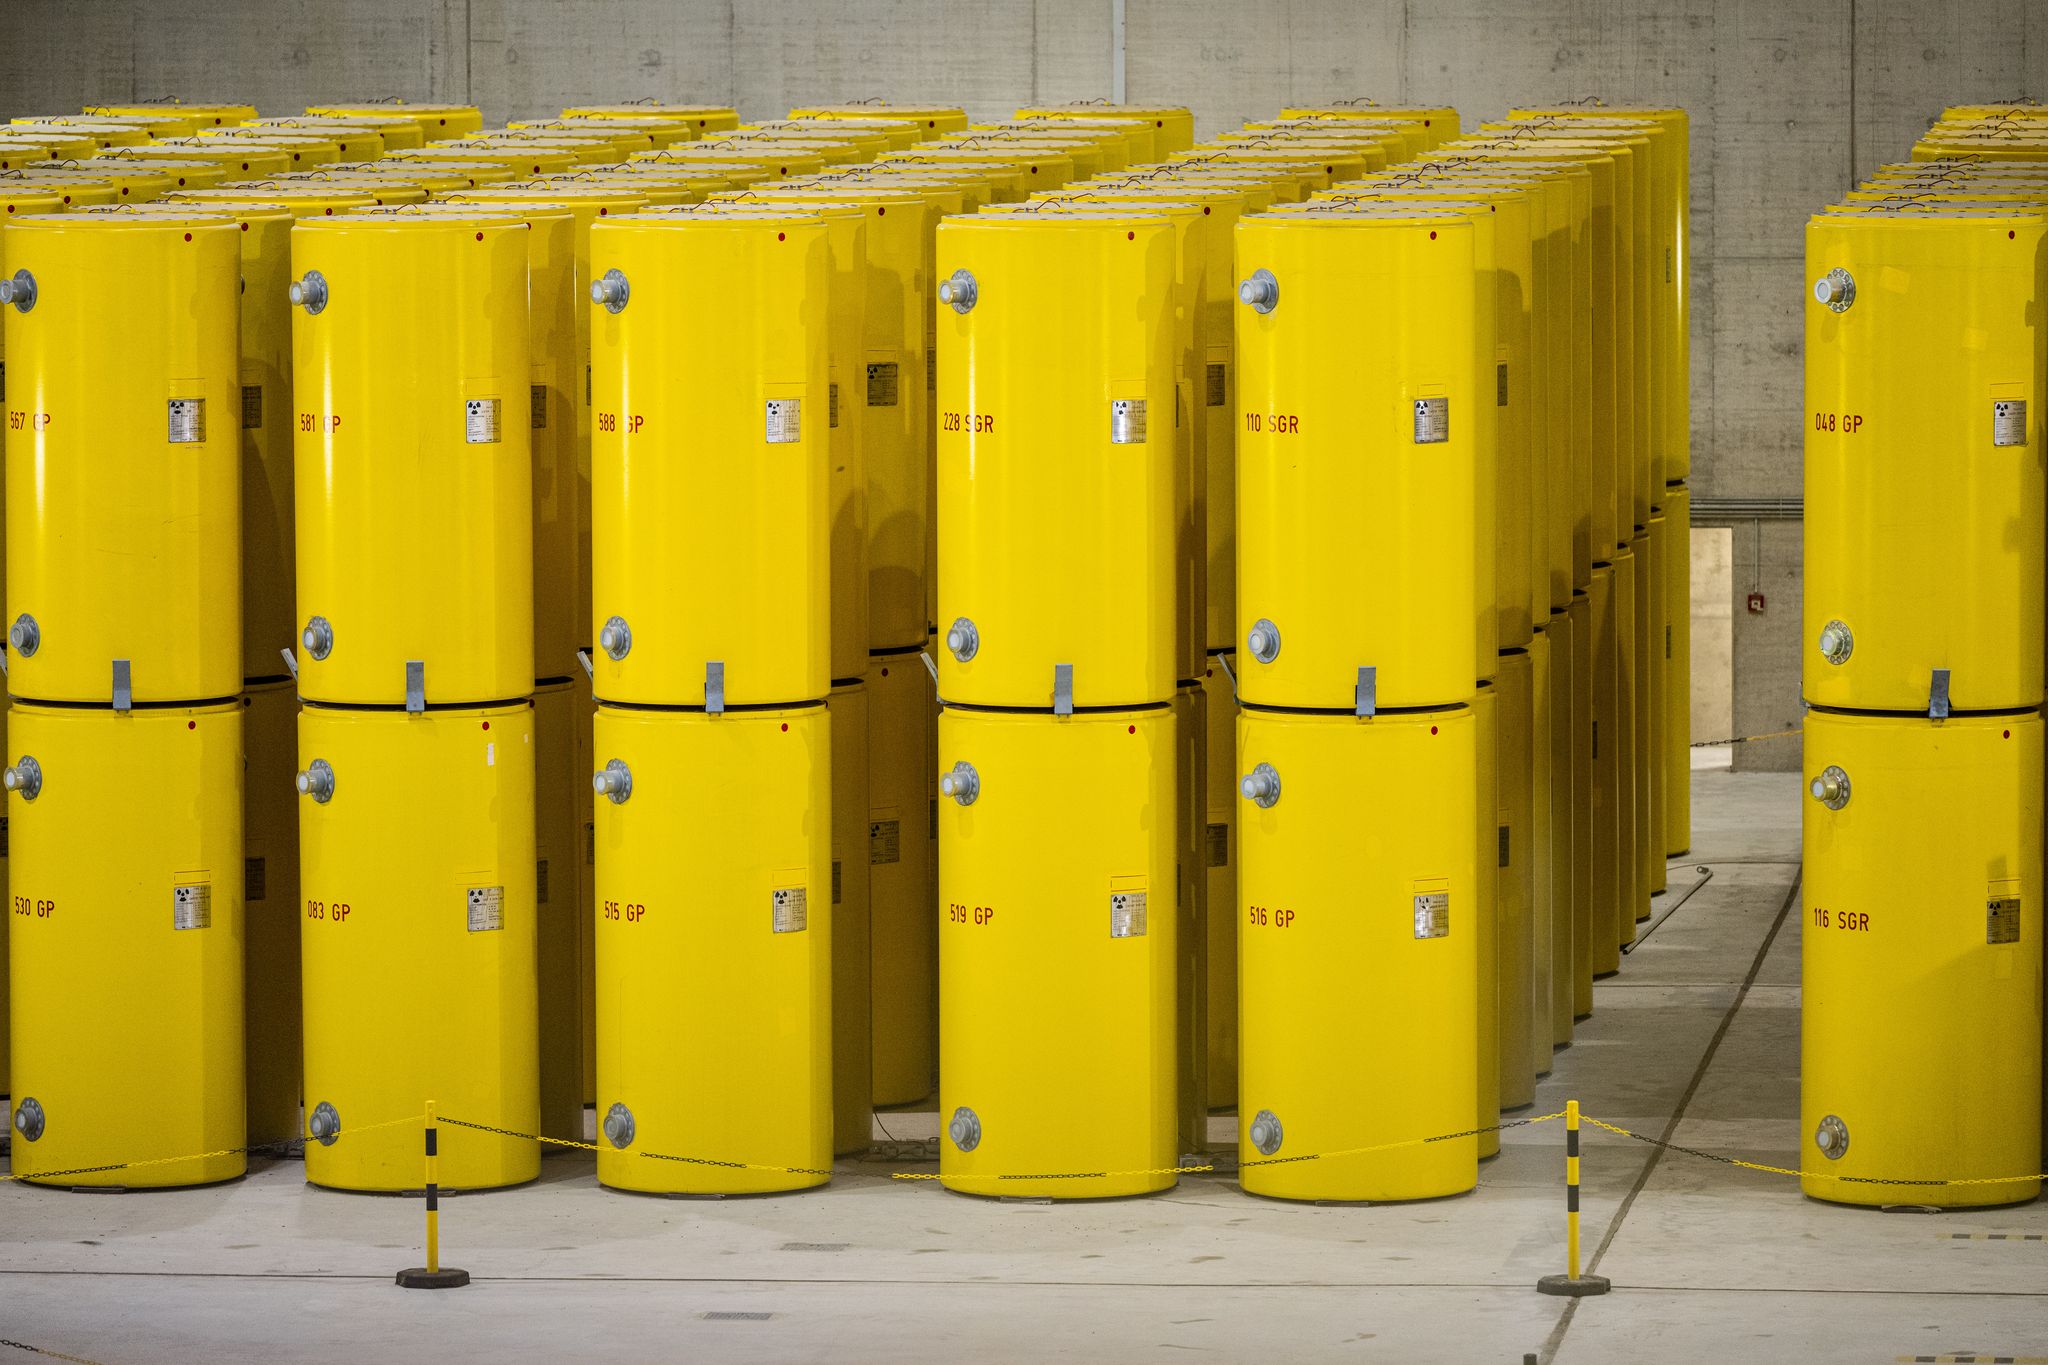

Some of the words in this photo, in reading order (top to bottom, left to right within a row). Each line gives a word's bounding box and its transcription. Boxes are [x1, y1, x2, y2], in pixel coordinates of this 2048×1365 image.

[11, 411, 26, 431] 567
[32, 413, 51, 432] GP
[301, 413, 316, 432] 581
[322, 415, 342, 433] GP
[599, 413, 616, 432] 588
[624, 414, 645, 433] GP
[944, 412, 961, 431] 228
[964, 414, 994, 433] SGR
[1246, 413, 1262, 432] 110
[1267, 415, 1299, 434] SGR
[1816, 413, 1836, 432] 048
[1842, 414, 1864, 434] GP
[15, 896, 32, 916] 530
[36, 899, 56, 918] GP
[307, 900, 325, 919] 083
[331, 903, 351, 923] GP
[605, 900, 620, 920] 515
[627, 904, 646, 923] GP
[950, 903, 967, 923] 519
[974, 906, 994, 926] GP
[1249, 906, 1268, 926] 516
[1274, 909, 1296, 929] GP
[1813, 908, 1830, 928] 116
[1837, 911, 1870, 932] SGR
